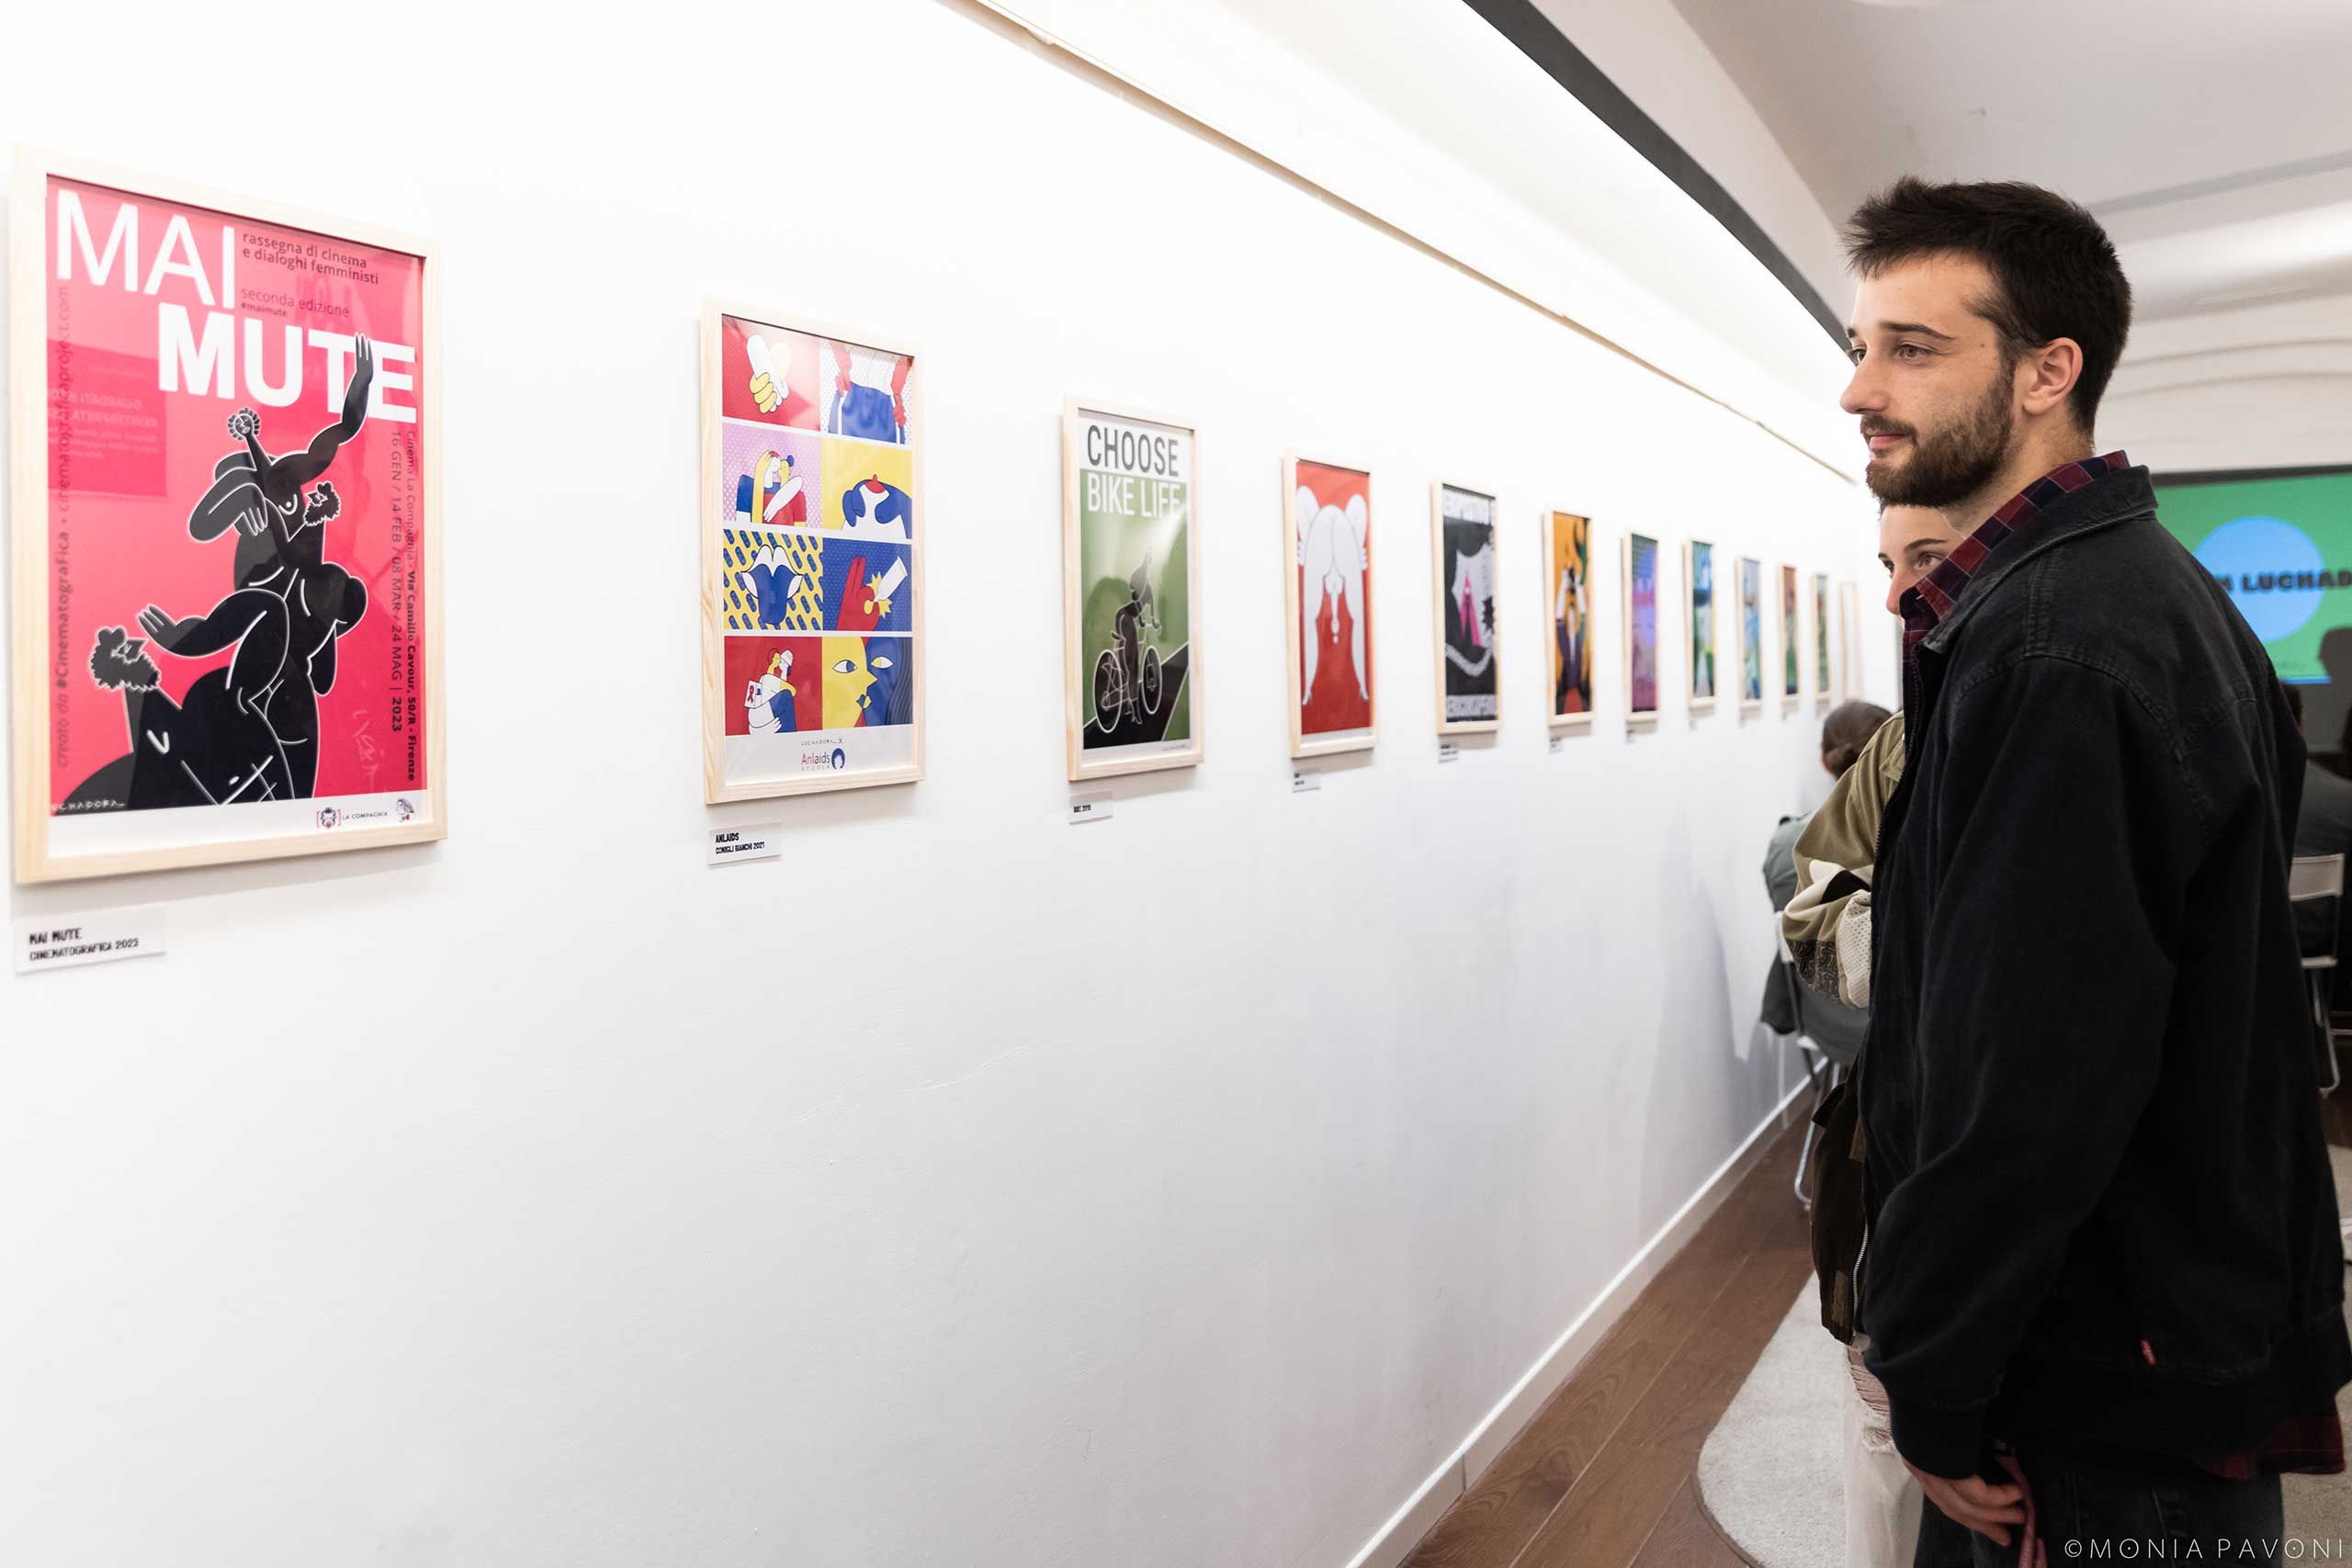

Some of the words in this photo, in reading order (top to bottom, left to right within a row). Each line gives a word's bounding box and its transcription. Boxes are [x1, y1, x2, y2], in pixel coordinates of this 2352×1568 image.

[57, 189, 235, 309] MAI
[243, 233, 302, 254] rassegna
[306, 244, 319, 258] di
[322, 249, 368, 268] cinema
[243, 247, 251, 257] e
[254, 248, 308, 271] dialoghi
[311, 260, 379, 285] femministi
[242, 288, 295, 308] seconda
[299, 299, 350, 318] edizione
[158, 302, 417, 423] MUTE
[390, 432, 401, 446] 16
[406, 431, 415, 475] Cinema
[1088, 425, 1179, 477] CHOOSE
[391, 451, 401, 481] GEN
[390, 498, 401, 513] 14
[1088, 471, 1136, 516] BIKE
[391, 517, 401, 543] FEB
[404, 495, 416, 559] Compagnia
[391, 557, 401, 573] 08
[407, 570, 416, 591] Via
[391, 578, 401, 611] MAR
[391, 625, 402, 642] 24
[407, 593, 416, 641] Camillo
[392, 647, 402, 682] MAG
[407, 646, 417, 694] Cavour,
[392, 697, 402, 732] 2023
[407, 696, 416, 726] 50/R
[407, 735, 416, 782] Firenze
[801, 751, 831, 765] Anlaids
[715, 832, 740, 844] ANLAIDS
[29, 931, 48, 945] MAI
[52, 927, 83, 942] MUTE
[29, 942, 112, 961] CINEMATOGRAFICA
